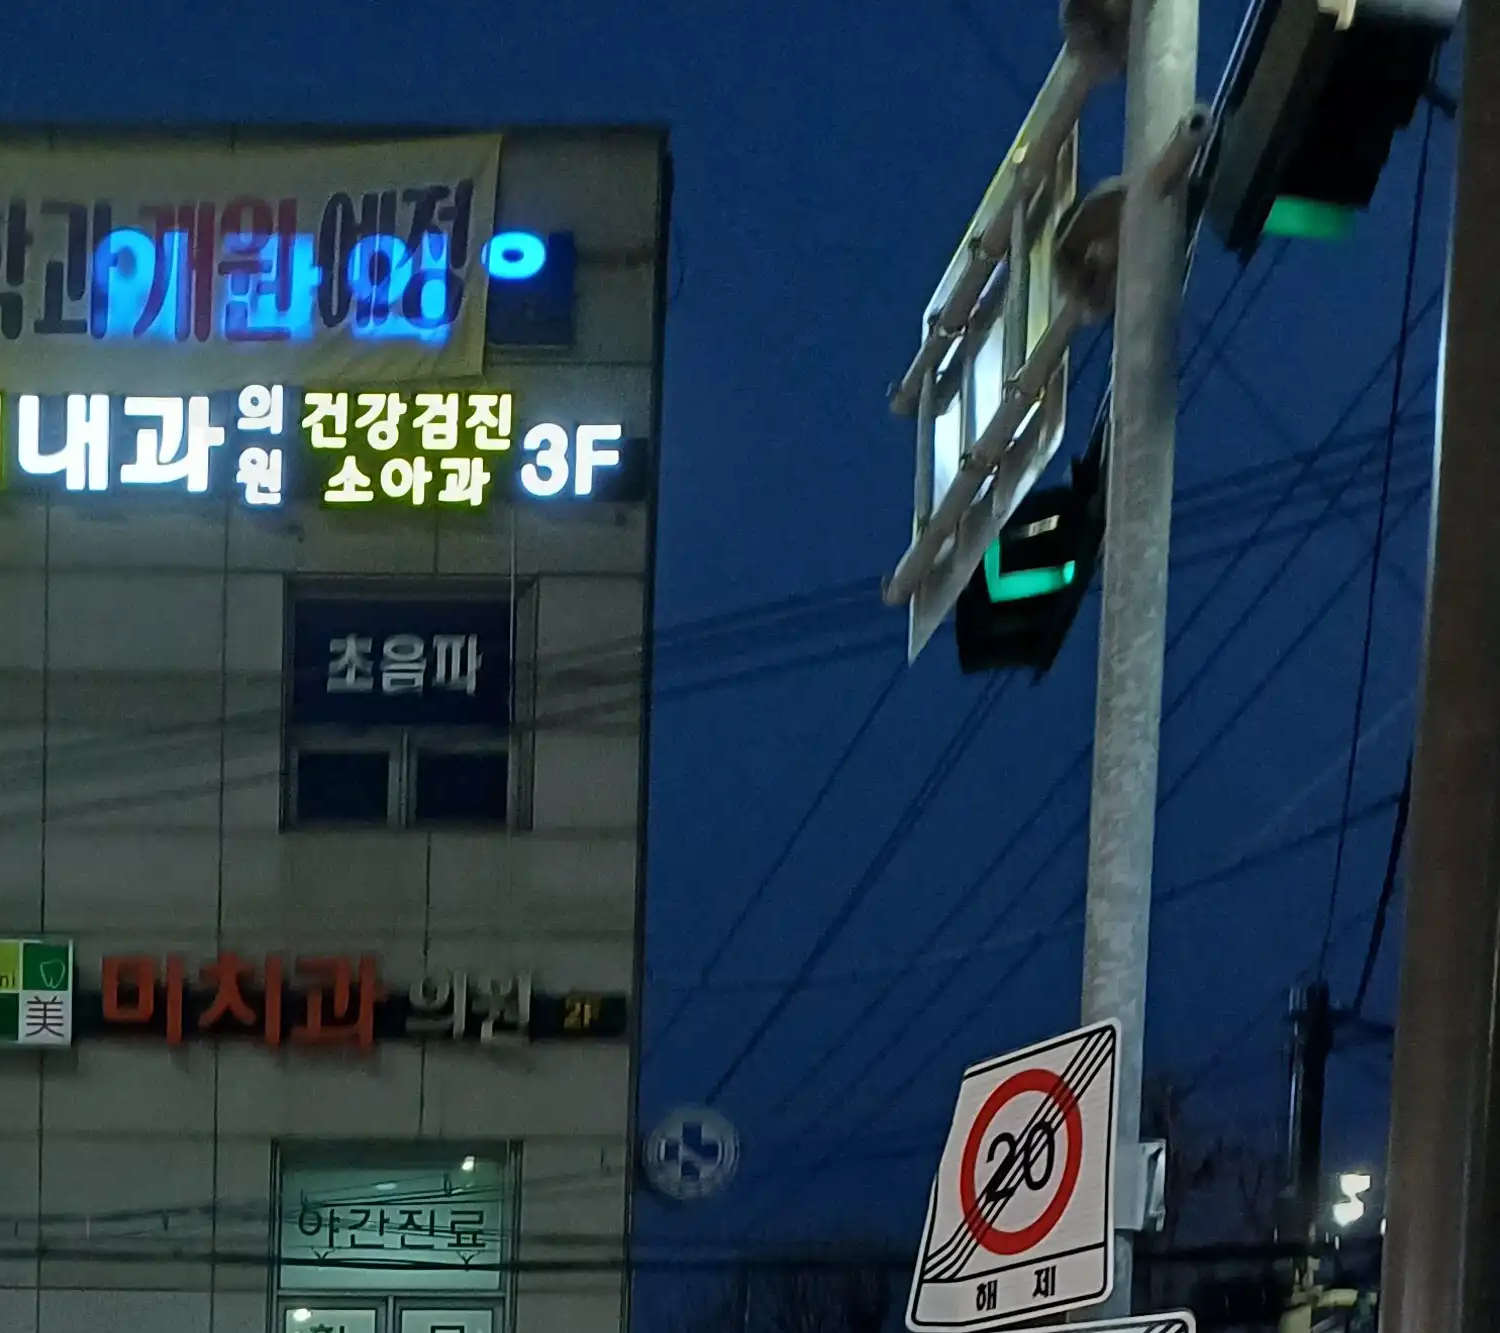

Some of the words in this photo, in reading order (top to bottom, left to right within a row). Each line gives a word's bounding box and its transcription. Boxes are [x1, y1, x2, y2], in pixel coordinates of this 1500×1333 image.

[302, 392, 514, 451] 건강검진
[324, 455, 491, 506] 소아과
[520, 422, 623, 497] 3F
[326, 632, 483, 699] 초음파
[25, 994, 66, 1039] 美
[101, 952, 386, 1047] 미치과
[985, 1120, 1057, 1203] 20
[297, 1203, 489, 1251] 야간진료
